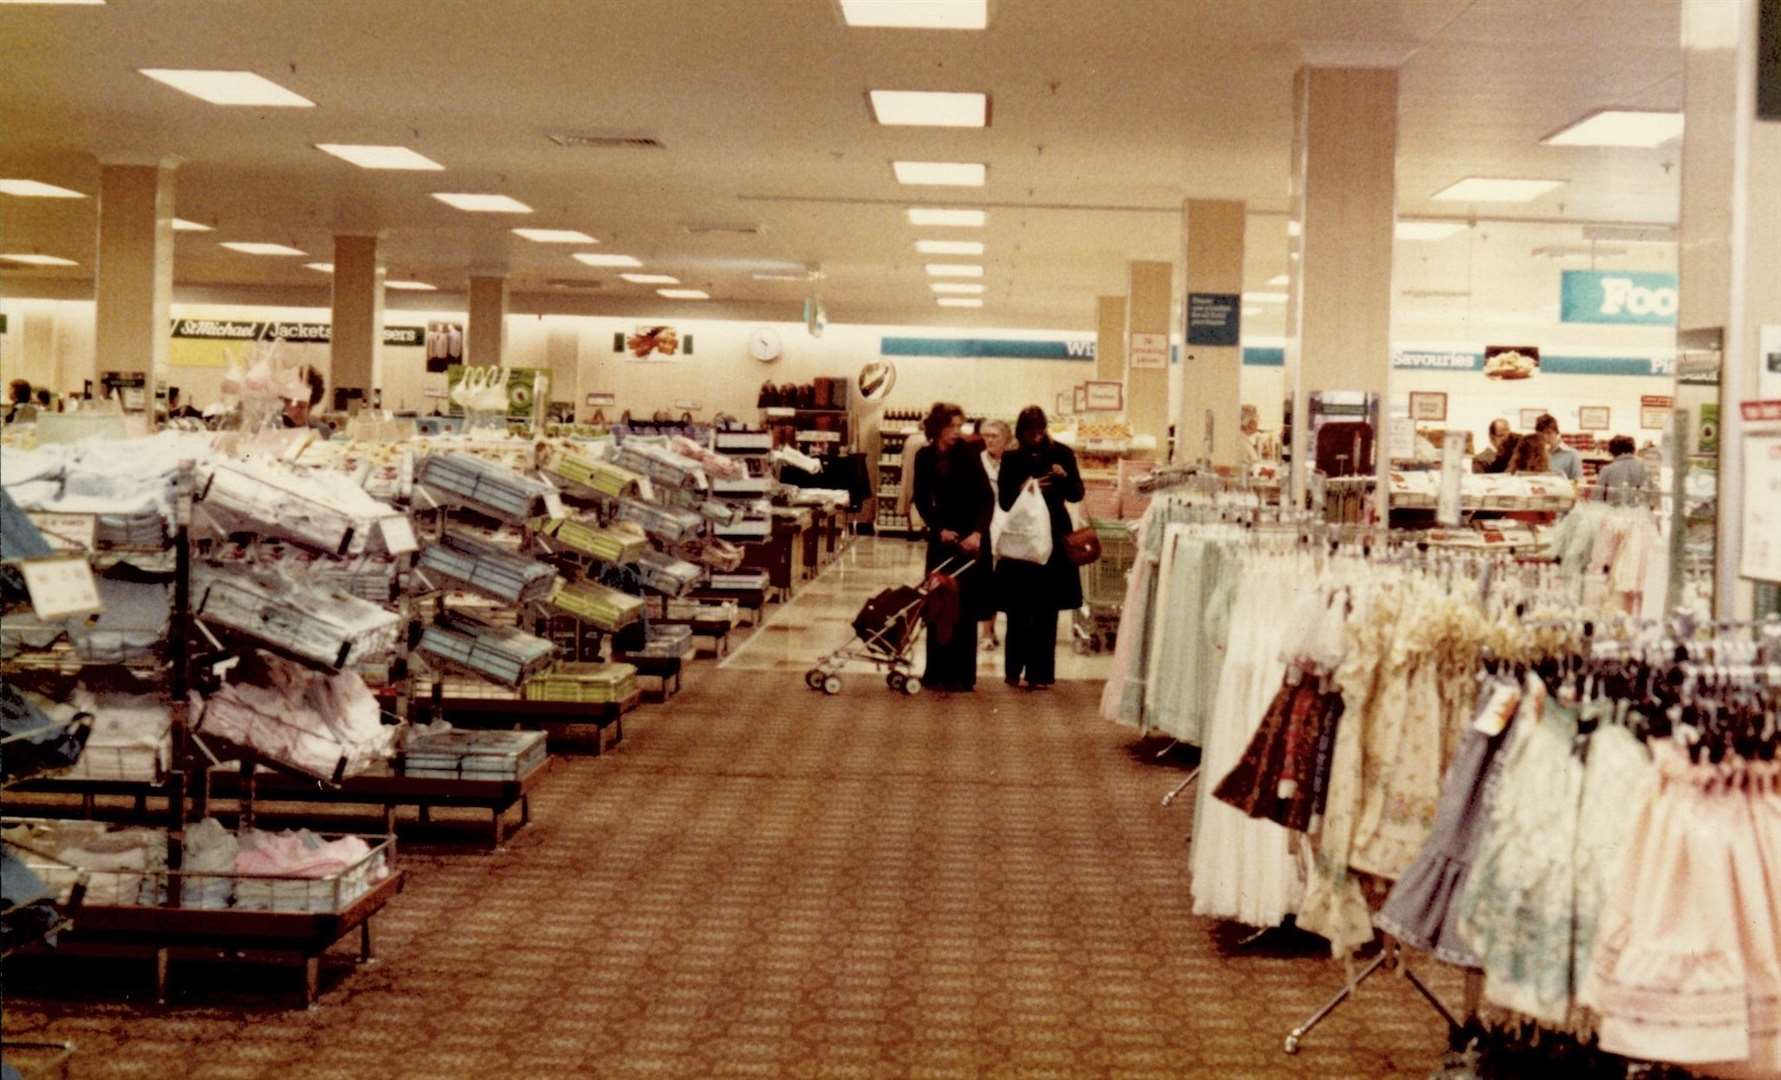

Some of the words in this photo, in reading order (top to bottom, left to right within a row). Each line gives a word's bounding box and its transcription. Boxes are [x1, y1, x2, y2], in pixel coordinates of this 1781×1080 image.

[1601, 278, 1678, 316] Foo
[383, 329, 415, 341] sers
[1392, 351, 1473, 367] Savouries
